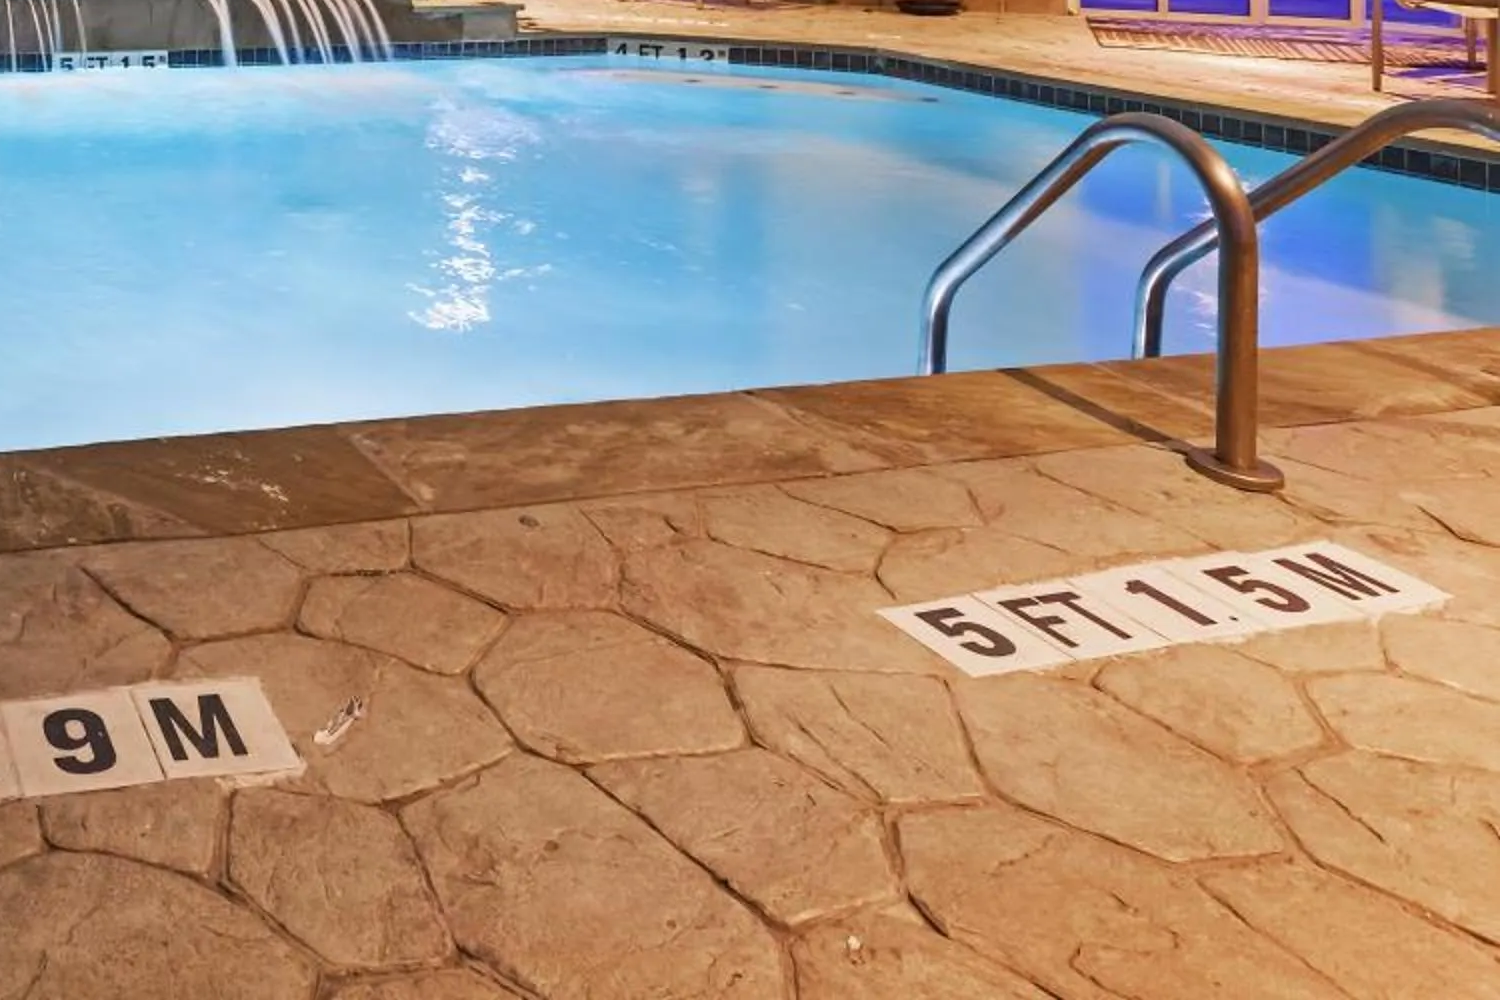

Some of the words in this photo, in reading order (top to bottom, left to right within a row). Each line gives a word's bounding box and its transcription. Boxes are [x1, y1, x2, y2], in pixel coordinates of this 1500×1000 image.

[915, 607, 1017, 657] 5
[996, 591, 1132, 648] FT
[1272, 552, 1400, 601] M
[149, 693, 250, 761] M
